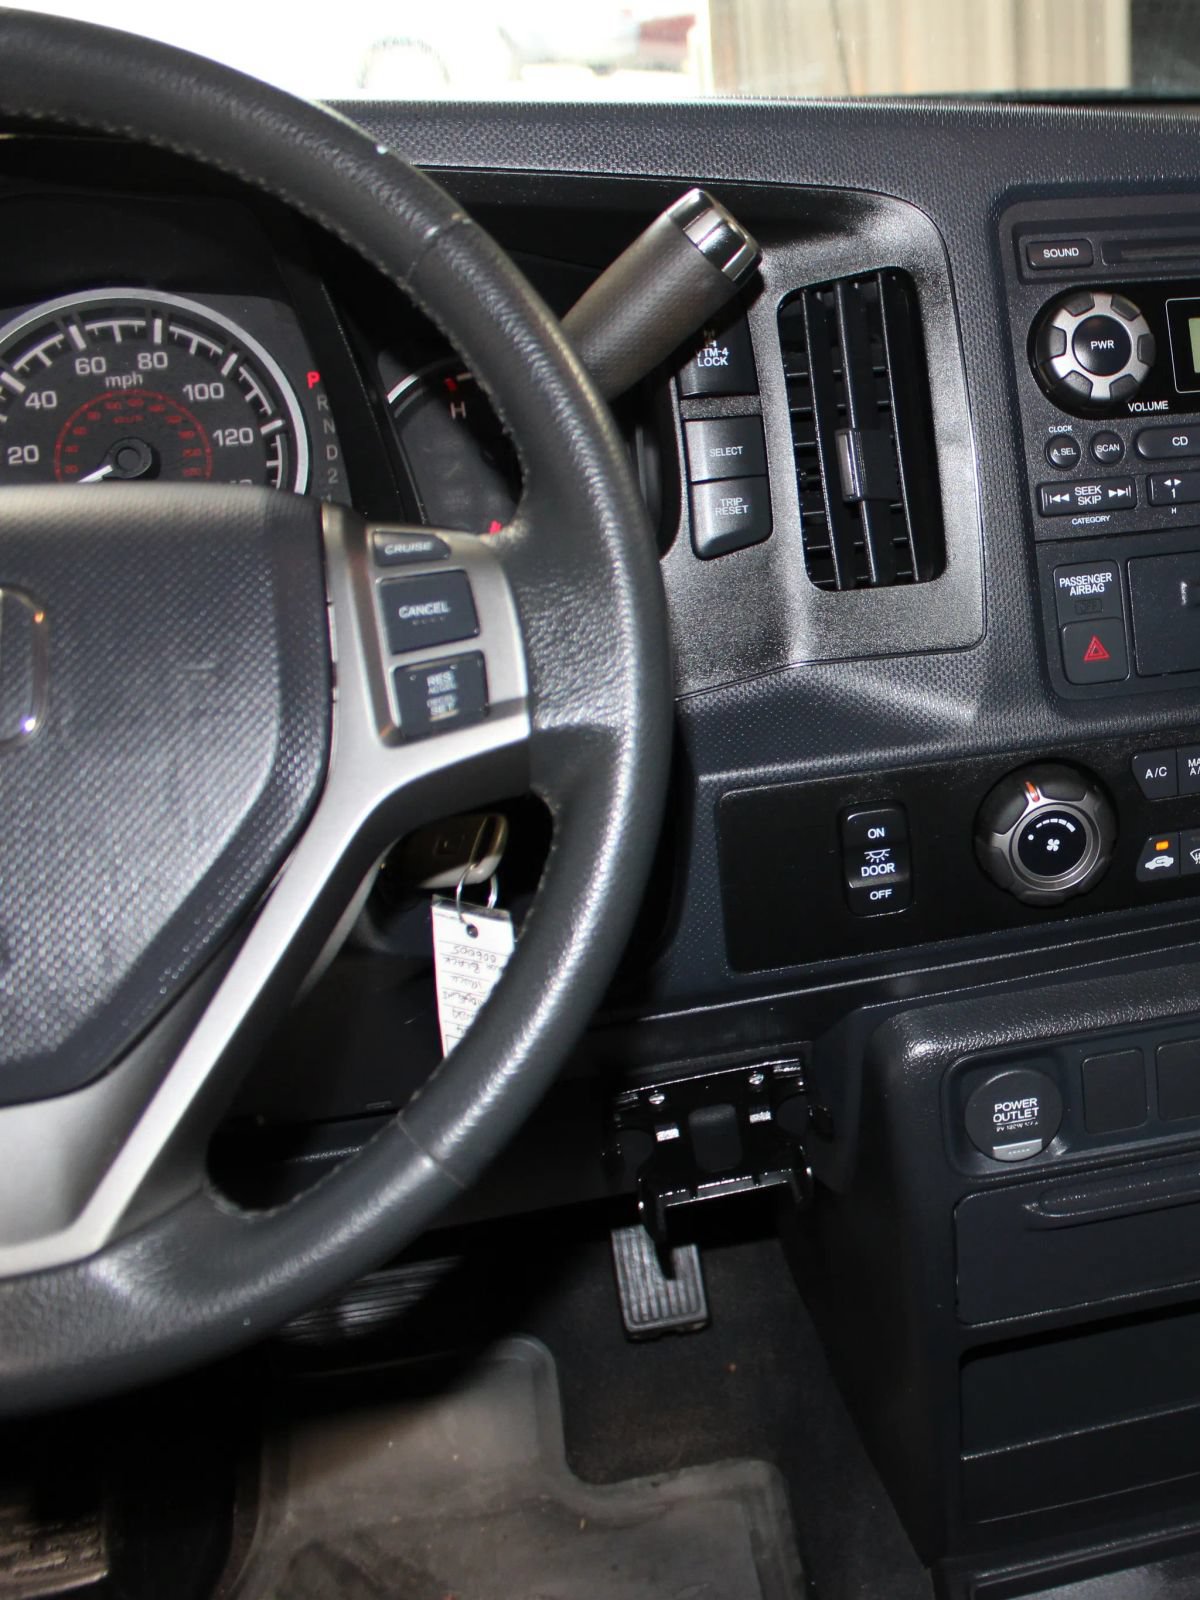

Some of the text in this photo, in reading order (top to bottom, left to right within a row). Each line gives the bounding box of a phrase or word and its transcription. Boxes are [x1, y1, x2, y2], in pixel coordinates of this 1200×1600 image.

[1043, 247, 1079, 258] SOUND
[1090, 340, 1115, 350] PWR
[75, 356, 107, 375] 60
[138, 352, 168, 371] 80
[697, 356, 728, 367] LOCK
[104, 372, 143, 390] mph
[307, 371, 320, 390] P
[183, 383, 225, 401] 100
[25, 391, 57, 410] 40
[317, 395, 329, 411] R
[1128, 400, 1169, 413] VOLUME
[324, 419, 335, 434] N
[1048, 425, 1073, 433] CLOCK
[213, 427, 253, 447] 120
[1172, 436, 1188, 446] CD
[8, 445, 39, 465] 20
[327, 446, 338, 460] D
[709, 446, 743, 457] SELECT
[1096, 444, 1120, 453] SCAN
[328, 469, 339, 484] 2
[1074, 485, 1102, 496] SEEK
[1171, 488, 1176, 499] 1
[720, 497, 743, 508] TRIP
[1077, 495, 1102, 506] SKIP
[715, 505, 749, 516] RESET
[1171, 507, 1177, 515] H
[1071, 515, 1111, 525] CATEGORY
[384, 541, 432, 555] CRUISE
[1059, 572, 1113, 588] PASSENGER
[1069, 583, 1105, 596] AIRBAG
[399, 601, 449, 618] CANCEL
[1144, 767, 1167, 779] A/C
[867, 827, 885, 839] ON
[861, 863, 895, 877] DOOR
[870, 889, 892, 900] OFF
[994, 1097, 1038, 1113] POWER
[993, 1107, 1040, 1123] OUTLET
